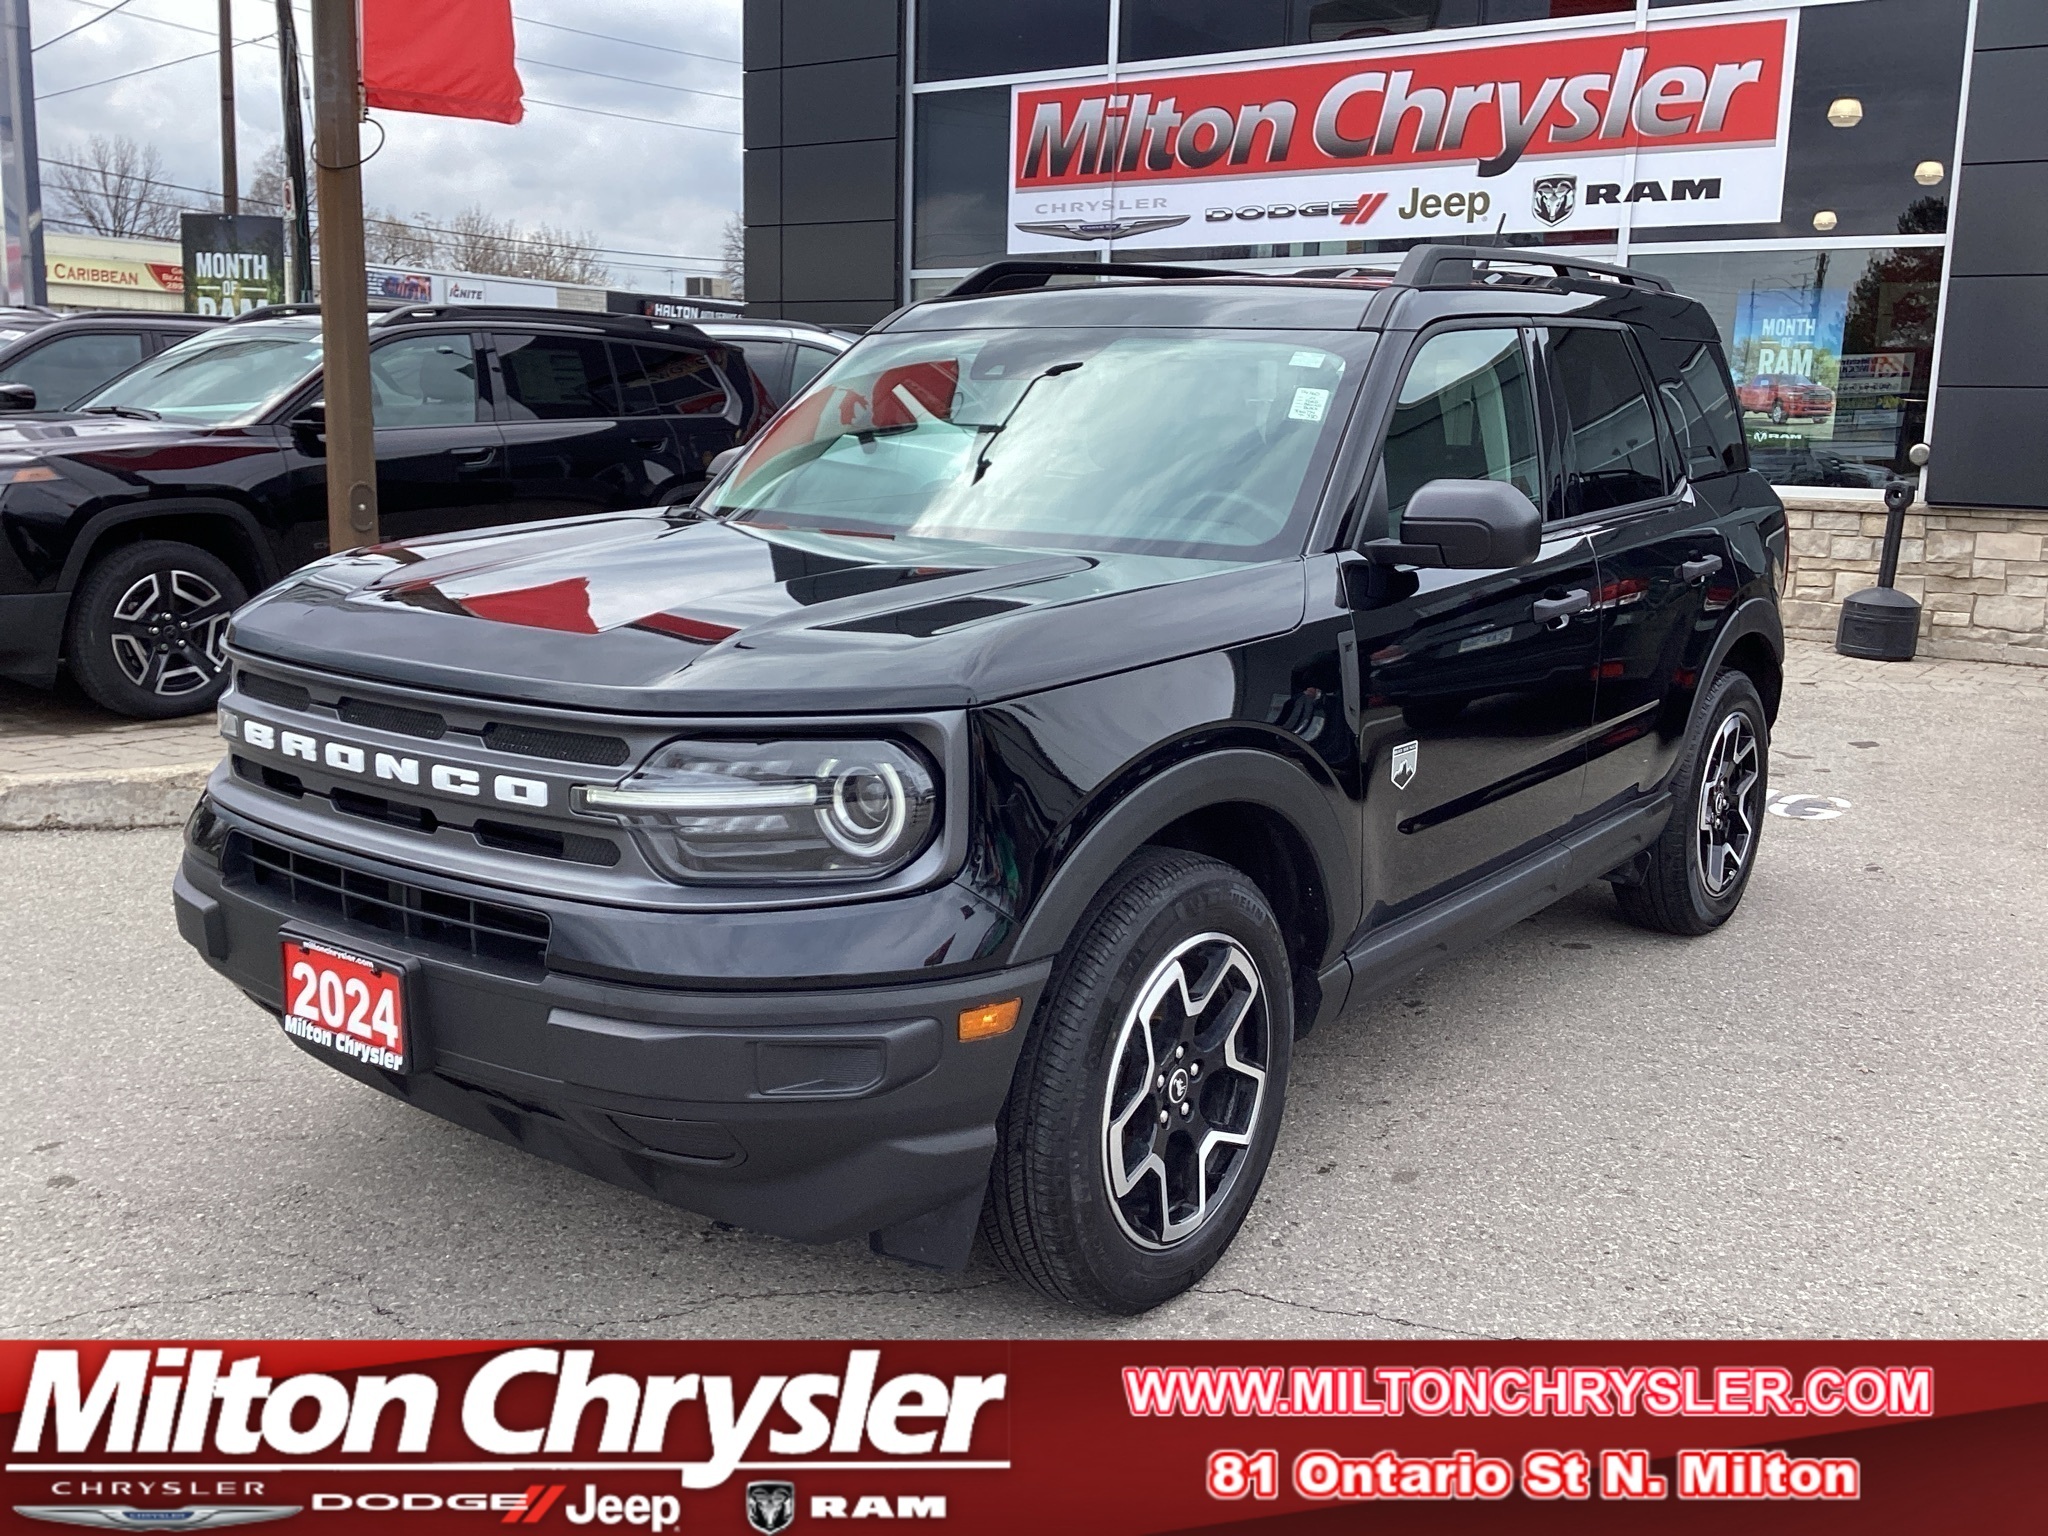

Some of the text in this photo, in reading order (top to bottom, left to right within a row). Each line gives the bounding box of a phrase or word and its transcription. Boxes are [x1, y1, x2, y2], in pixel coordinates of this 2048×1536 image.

[1020, 47, 1763, 180] Milton Chrysler
[1585, 177, 1722, 205] RAM
[1035, 197, 1168, 215] CHRYSLER
[1205, 200, 1360, 222] DODGE
[1398, 187, 1490, 223] Jeep
[54, 263, 139, 285] CARIBBEAN
[195, 252, 268, 280] MONTH
[222, 280, 238, 295] OF
[449, 288, 483, 300] IGNITE
[654, 303, 699, 319] HALTON
[1761, 318, 1816, 336] MONTH
[1781, 337, 1794, 348] OF
[1758, 348, 1814, 377] RAM
[1768, 432, 1802, 440] RAM
[243, 719, 548, 807] BRONCO
[292, 961, 399, 1049] 2024
[284, 1014, 403, 1071] Milton Chrysler
